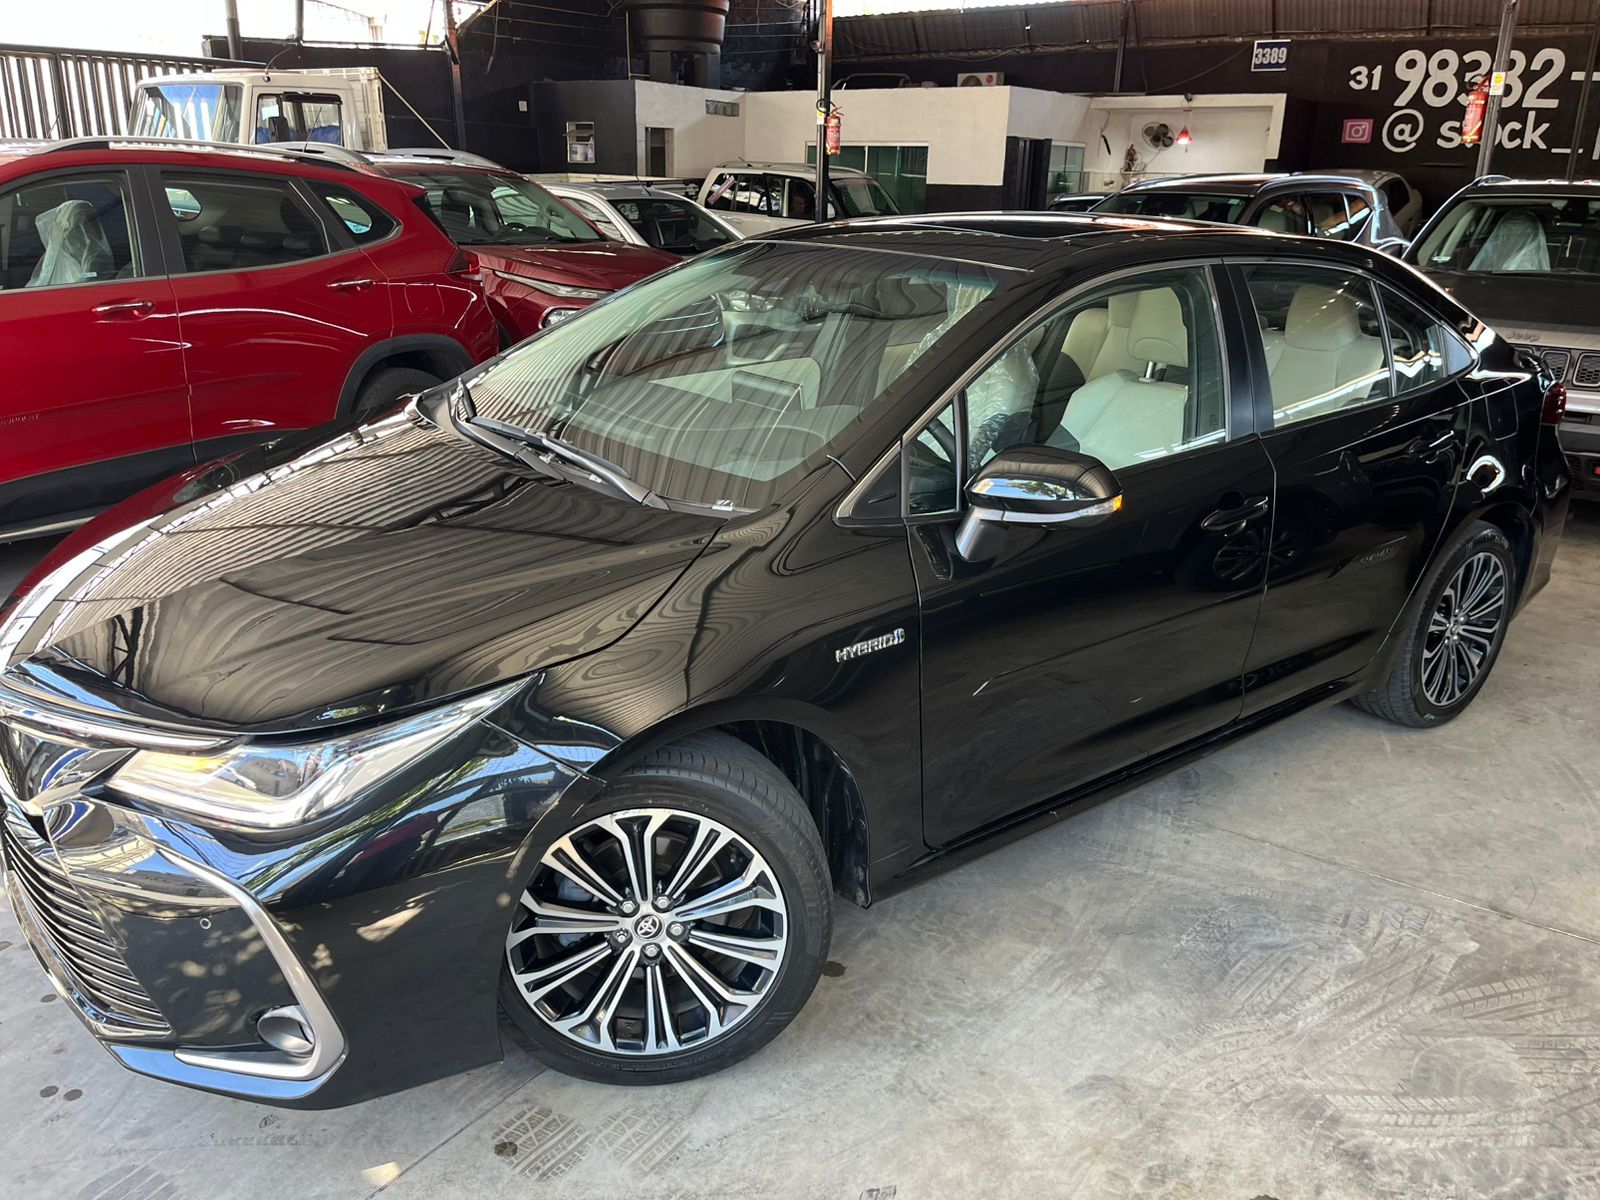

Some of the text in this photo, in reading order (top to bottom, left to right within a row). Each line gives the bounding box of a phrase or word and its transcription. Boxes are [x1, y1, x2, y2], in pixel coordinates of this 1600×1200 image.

[1255, 47, 1287, 64] 3389
[1349, 65, 1382, 90] 31
[835, 633, 895, 663] HYBRID
